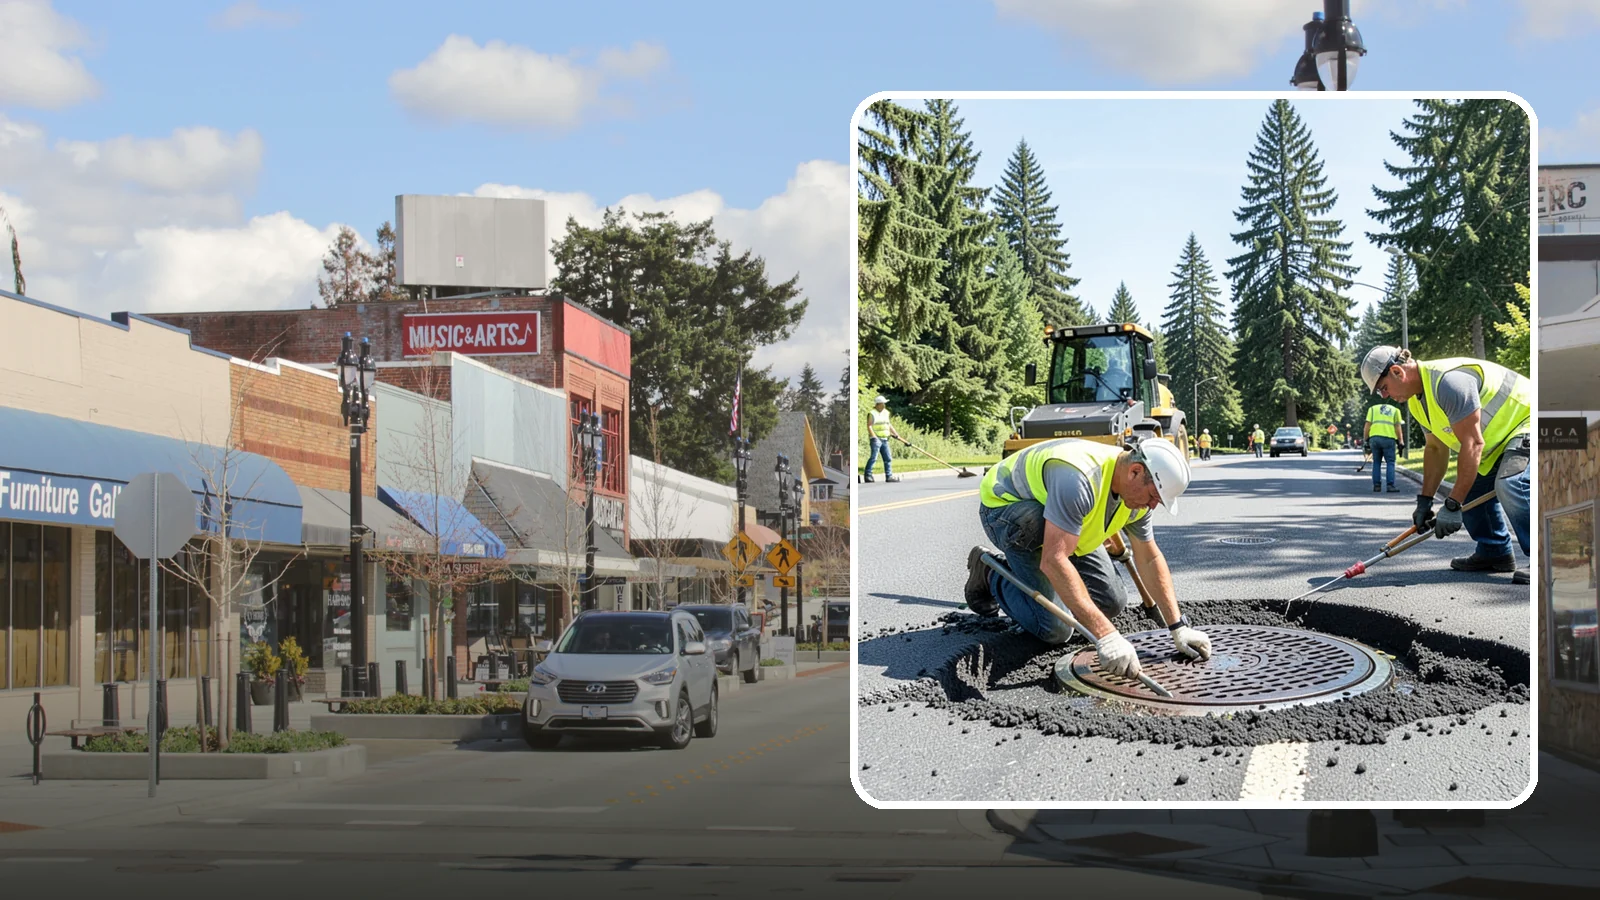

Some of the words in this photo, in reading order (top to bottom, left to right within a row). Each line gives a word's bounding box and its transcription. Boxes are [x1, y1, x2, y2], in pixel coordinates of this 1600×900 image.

[409, 323, 519, 348] MUSIC&ARTS
[0, 471, 79, 515] Furniture
[89, 482, 122, 518] Gal
